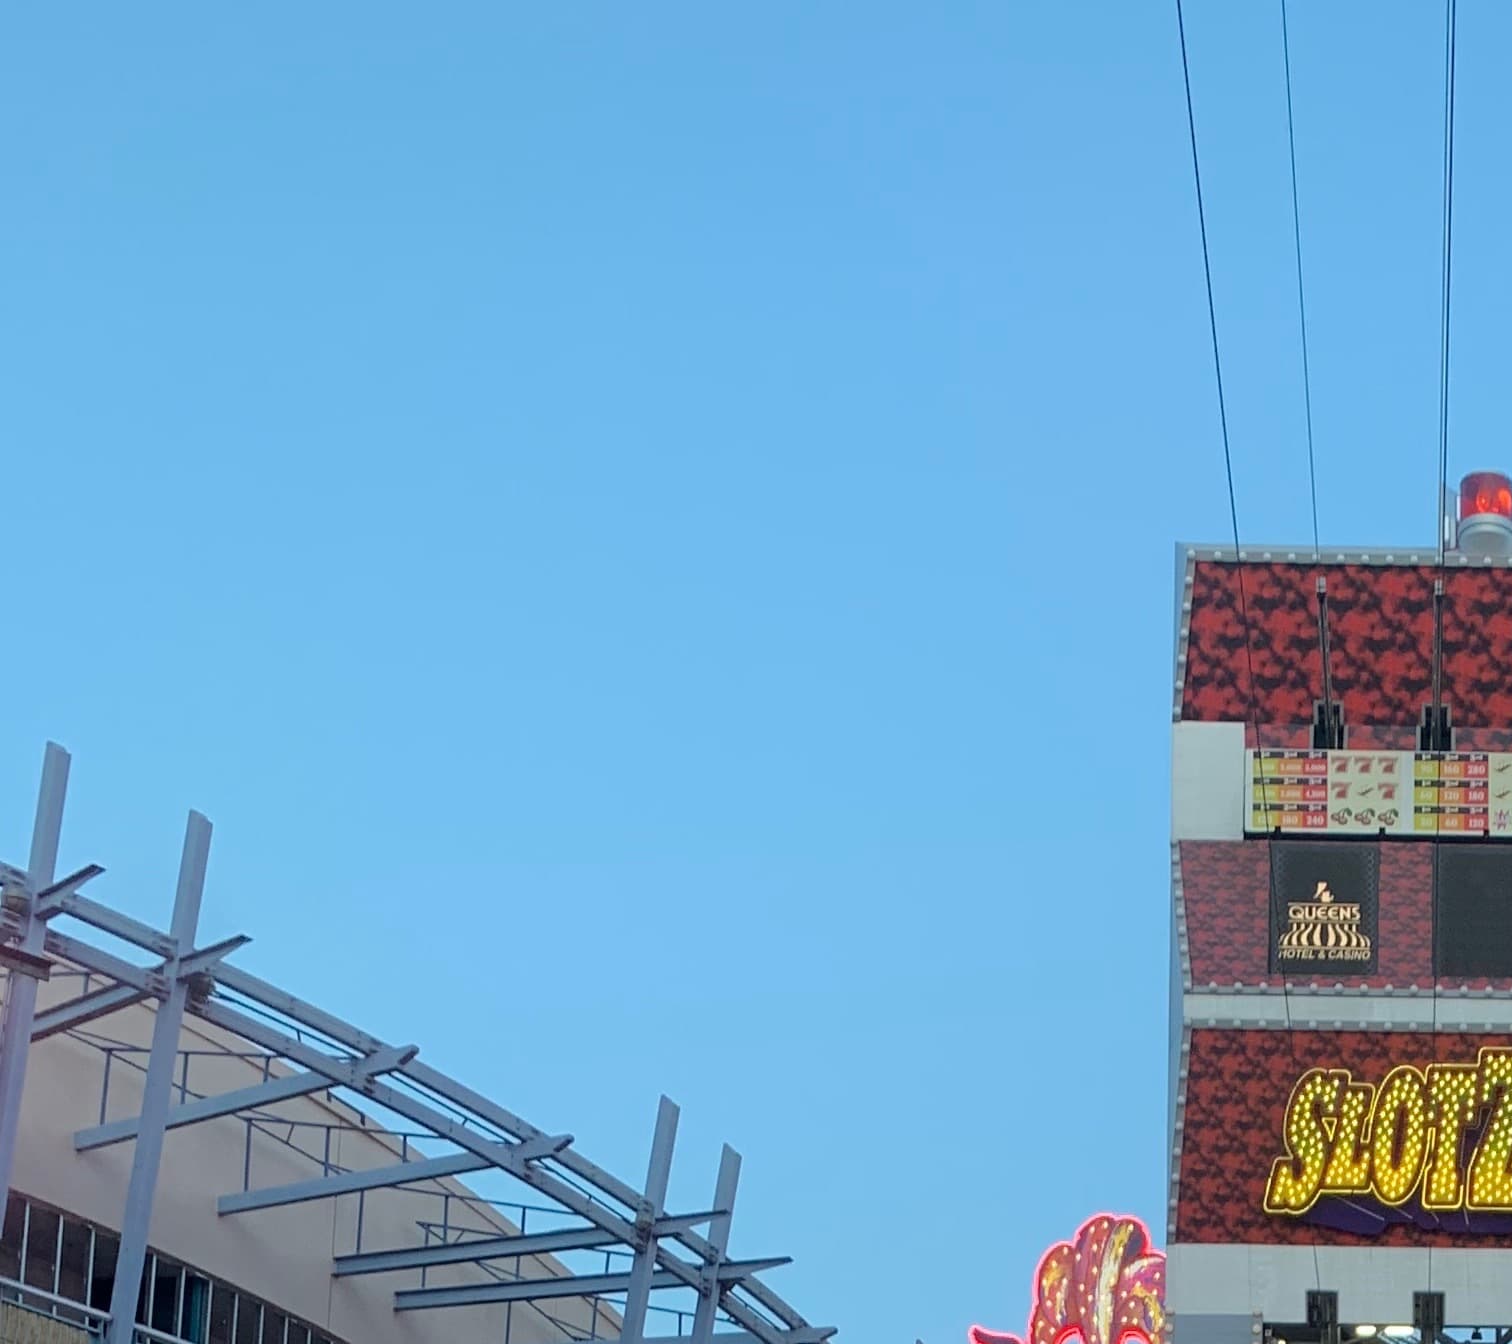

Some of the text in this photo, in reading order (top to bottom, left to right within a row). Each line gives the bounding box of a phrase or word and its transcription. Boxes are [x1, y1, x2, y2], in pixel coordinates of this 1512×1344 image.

[1289, 905, 1361, 921] QUEENS
[1278, 948, 1372, 961] HOTEL & CASINO
